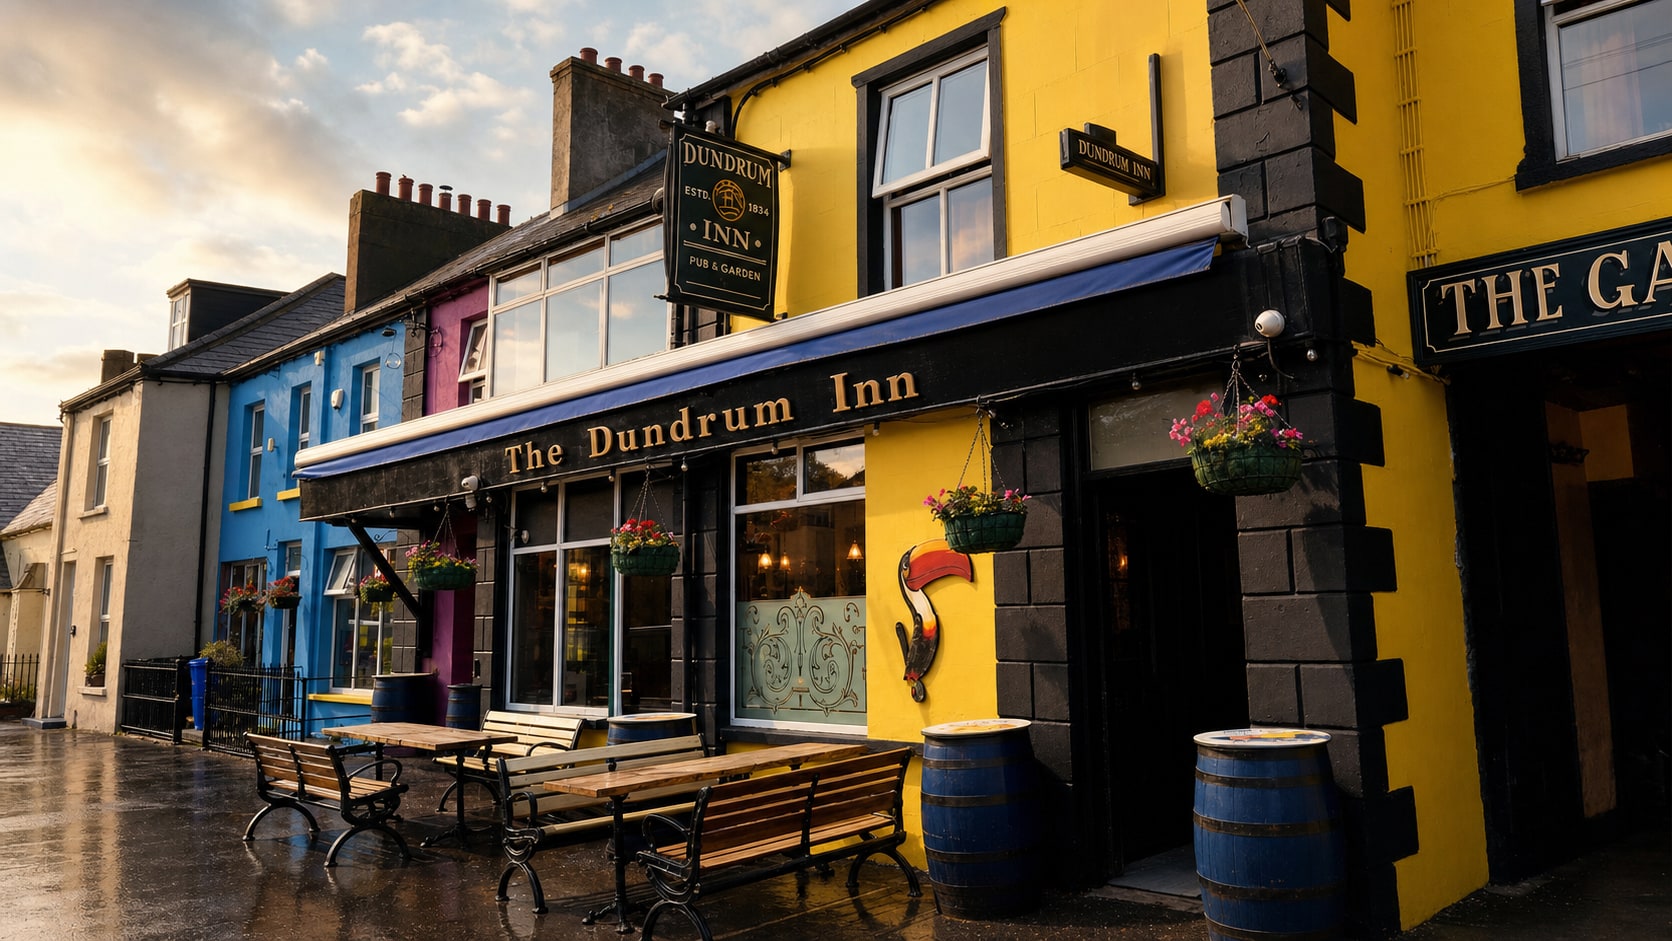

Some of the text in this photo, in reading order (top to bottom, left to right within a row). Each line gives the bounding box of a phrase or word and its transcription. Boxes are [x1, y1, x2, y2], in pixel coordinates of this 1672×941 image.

[683, 141, 771, 188] DUNDRUM
[1078, 139, 1151, 180] DUNDRUM INN
[685, 185, 769, 217] ESTD. 1834
[703, 218, 750, 250] INN
[689, 256, 761, 282] PUB & GARDEN
[1441, 263, 1563, 336] THE
[505, 371, 919, 474] The Dundrum Inn
